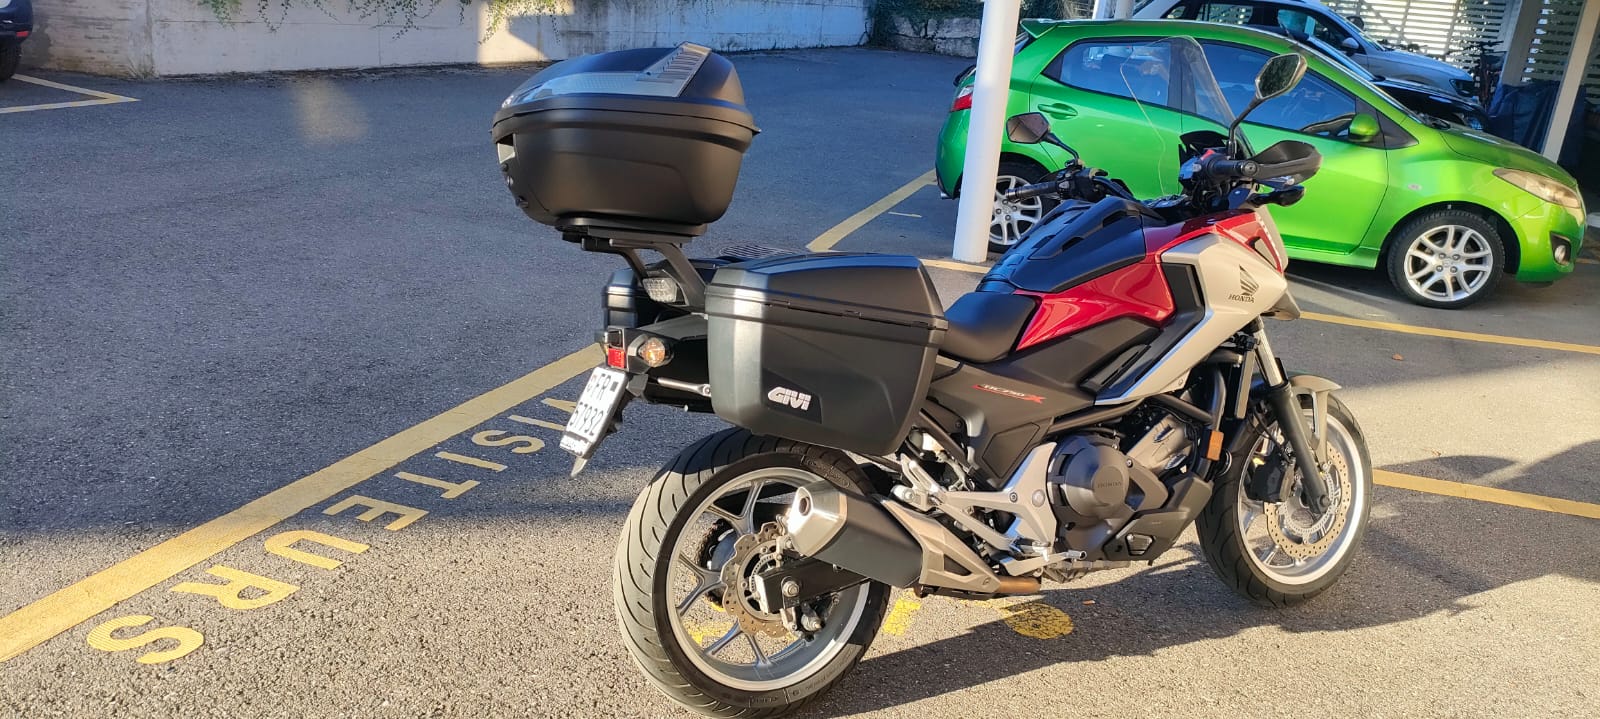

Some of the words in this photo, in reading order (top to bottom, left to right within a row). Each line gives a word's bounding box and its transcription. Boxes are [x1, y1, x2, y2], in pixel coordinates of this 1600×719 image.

[1228, 293, 1255, 303] HONDA
[590, 373, 611, 401] FR
[767, 386, 812, 411] GIVI
